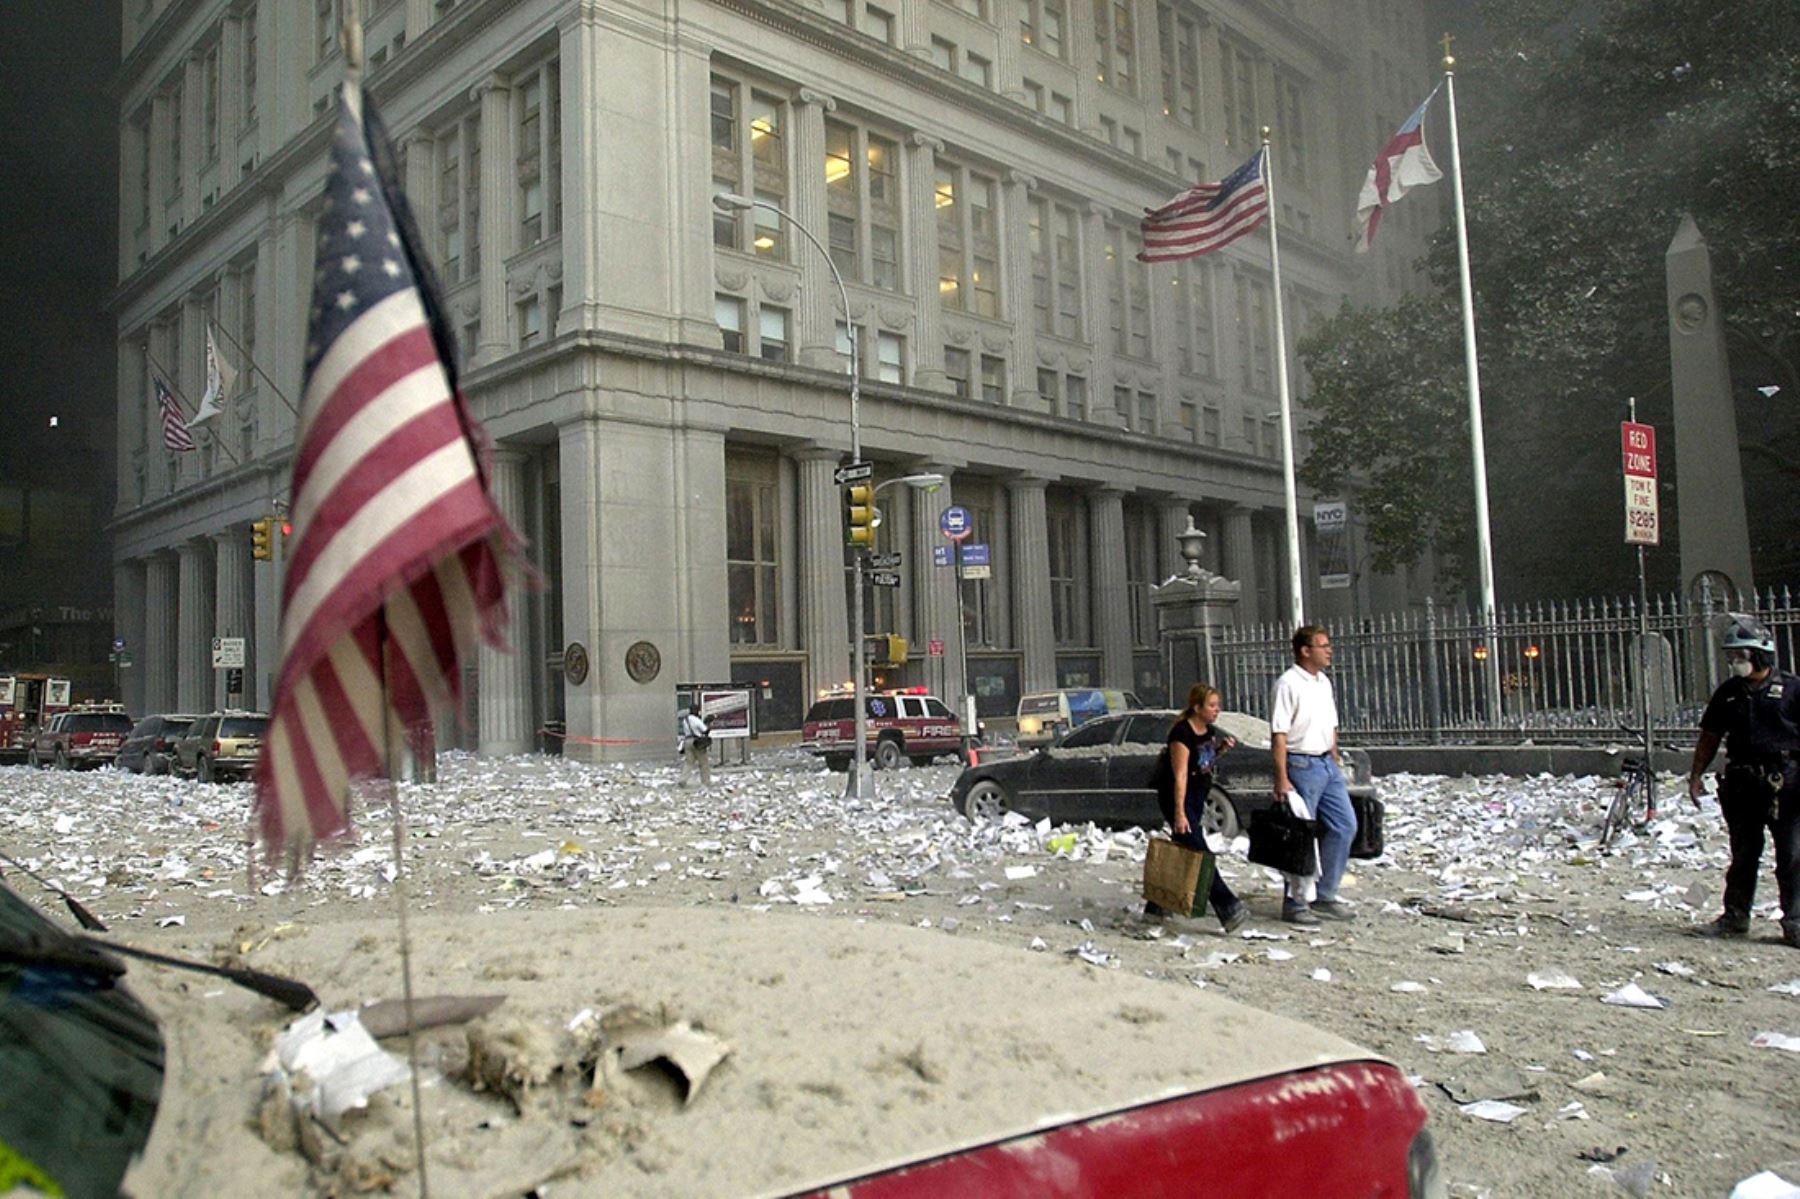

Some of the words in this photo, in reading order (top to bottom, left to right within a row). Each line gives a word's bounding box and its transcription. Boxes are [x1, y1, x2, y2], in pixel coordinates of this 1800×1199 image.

[1629, 430, 1648, 449] RED
[1628, 452, 1652, 472] ZONE
[1634, 493, 1650, 507] FINE
[1316, 508, 1343, 521] NYC
[922, 725, 952, 737] FIRE
